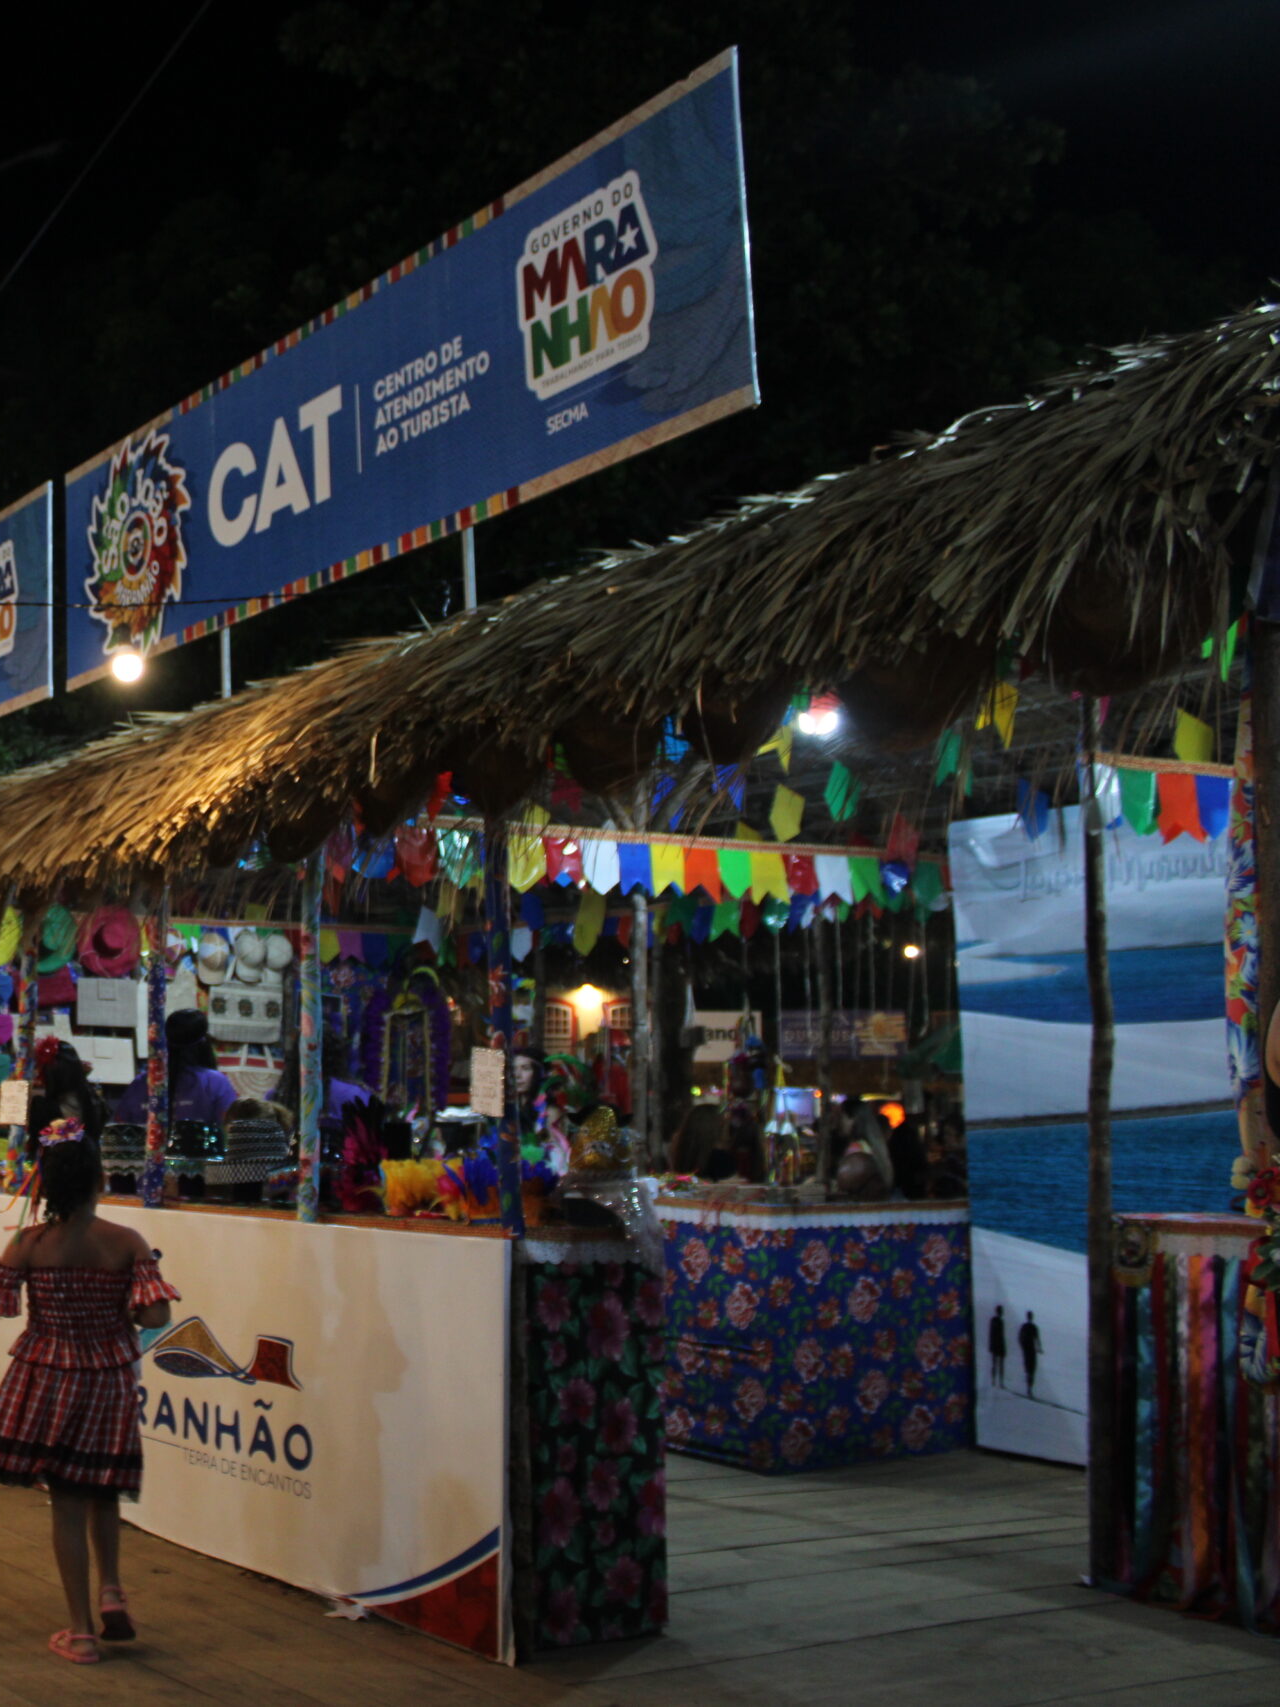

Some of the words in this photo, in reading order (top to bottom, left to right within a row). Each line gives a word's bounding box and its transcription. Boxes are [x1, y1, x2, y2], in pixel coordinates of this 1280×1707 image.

[530, 200, 604, 254] GOVERNO
[611, 182, 633, 207] DO
[373, 350, 438, 402] CENTRO
[441, 335, 463, 366] DE
[375, 350, 490, 430] ATENDIMENTO
[376, 427, 399, 456] AO
[401, 391, 471, 442] TURISTA
[546, 402, 589, 435] SECMA
[207, 384, 343, 548] CAT
[137, 1386, 313, 1471] RANHÃO
[183, 1447, 218, 1471] TERRA
[221, 1457, 239, 1478] DE
[240, 1463, 313, 1500] ENCANTOS
